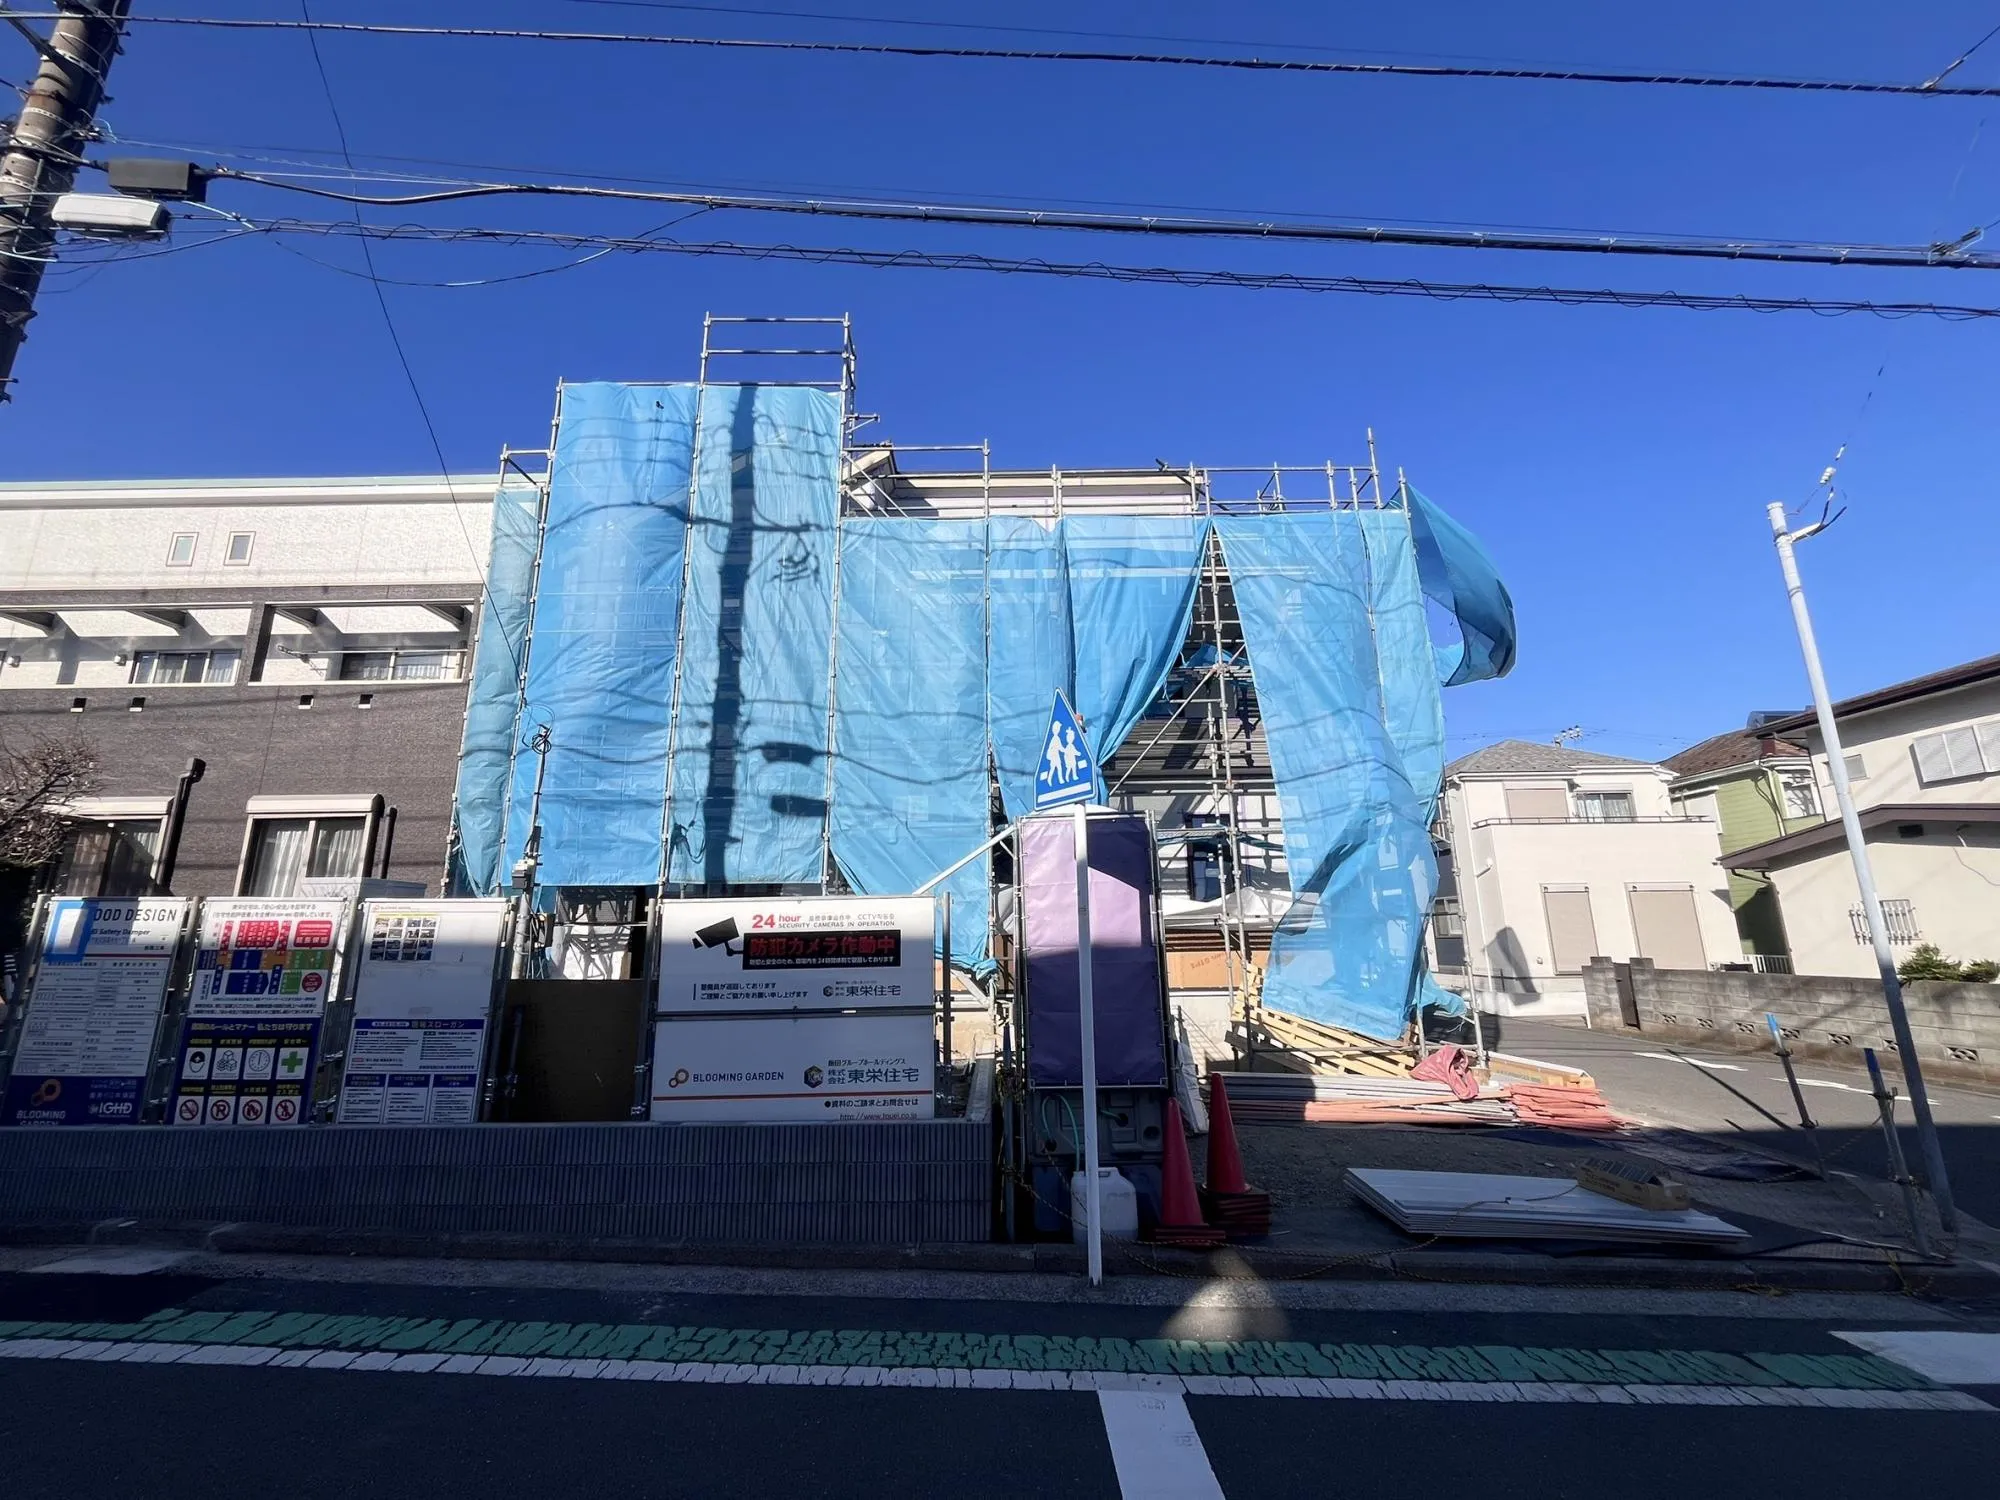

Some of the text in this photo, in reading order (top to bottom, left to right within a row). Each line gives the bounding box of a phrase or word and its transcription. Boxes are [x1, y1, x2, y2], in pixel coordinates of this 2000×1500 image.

[125, 908, 178, 921] DESIGN
[751, 914, 802, 929] 24 hour
[749, 936, 896, 957] 防犯カメラ作動中
[701, 991, 809, 1000] ご理解とご協力をお願い申し上げます
[846, 985, 902, 997] 東栄住宅
[828, 1057, 906, 1067] 飯田グループホールディングス
[692, 1071, 785, 1083] BLOOMING GARDEN
[828, 1068, 847, 1077] 株式
[848, 1067, 920, 1084] 東栄住宅
[828, 1077, 847, 1085] 会社
[16, 1109, 66, 1119] BLOOMING
